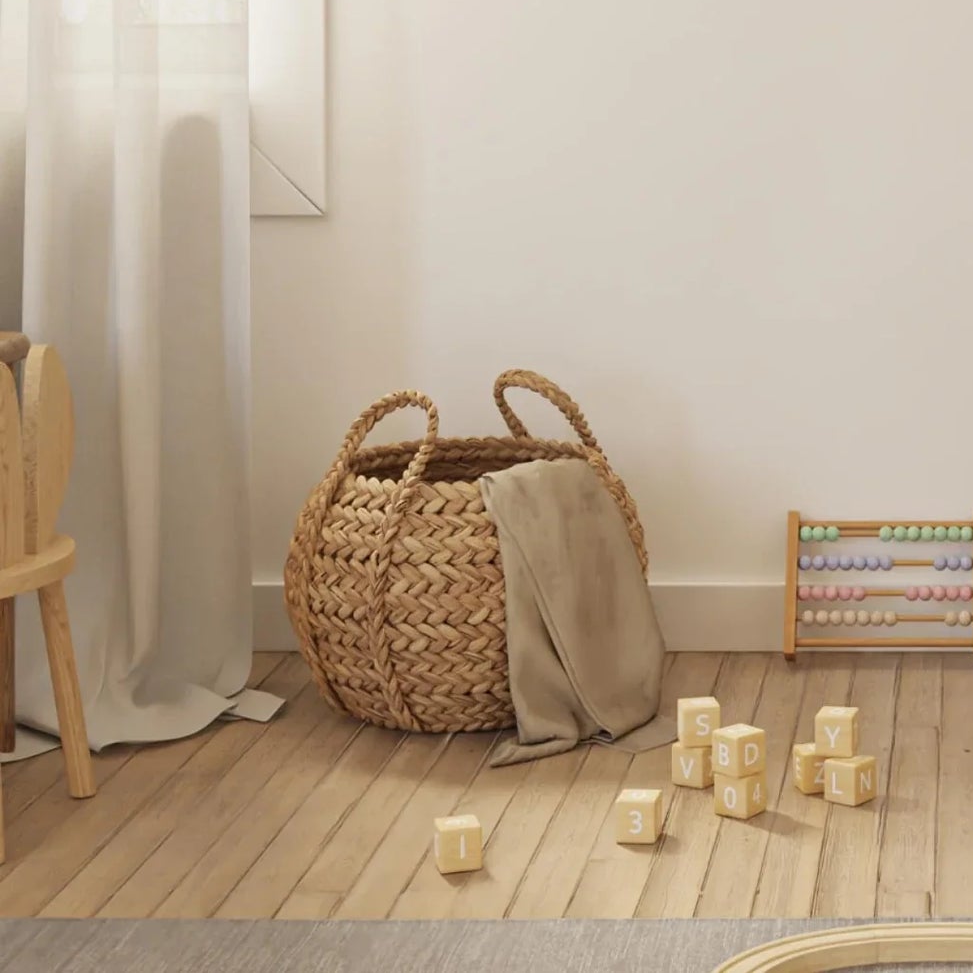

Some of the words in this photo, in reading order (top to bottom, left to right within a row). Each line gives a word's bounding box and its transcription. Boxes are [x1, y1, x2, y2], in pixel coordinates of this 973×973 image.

[696, 715, 710, 736] S
[825, 727, 841, 749] Y
[719, 743, 730, 766] B
[745, 743, 759, 766] D
[681, 757, 694, 779] V
[832, 772, 843, 795] L
[861, 770, 872, 794] N
[629, 811, 643, 834] 3
